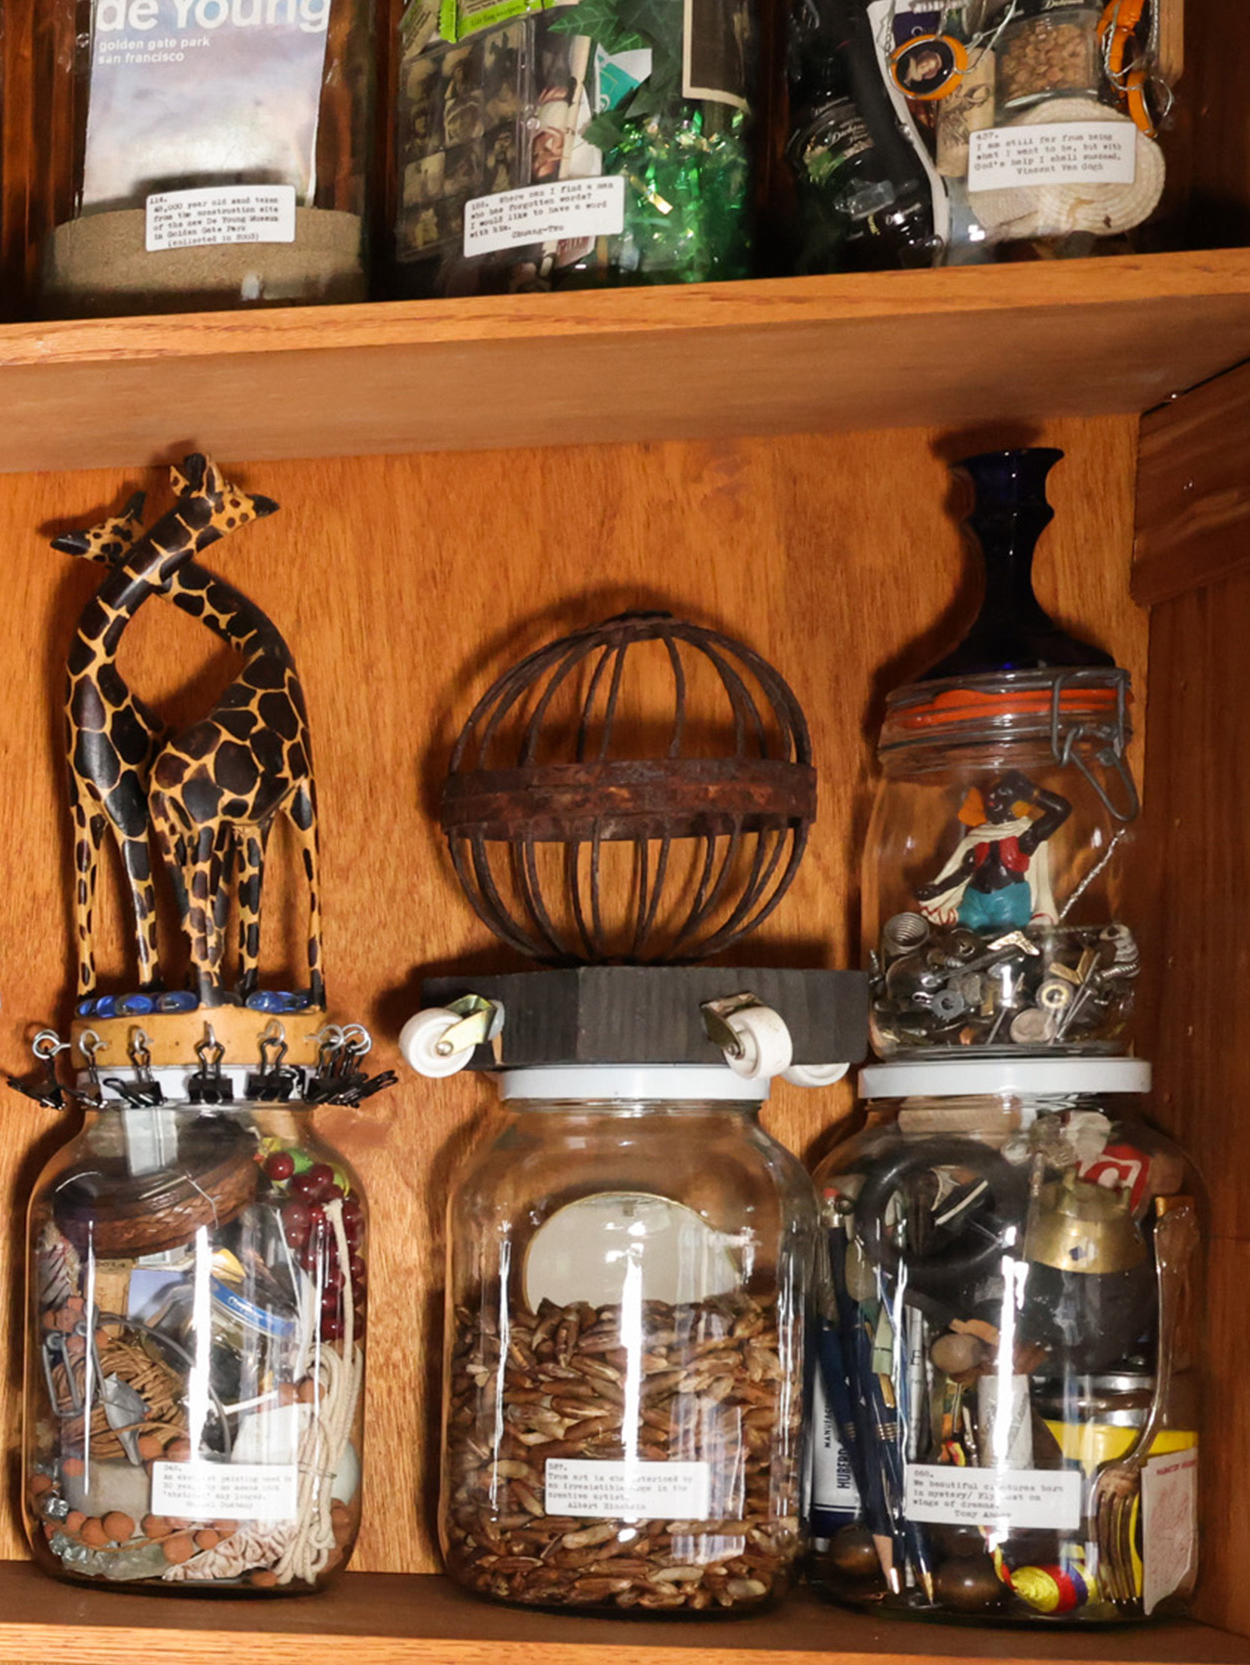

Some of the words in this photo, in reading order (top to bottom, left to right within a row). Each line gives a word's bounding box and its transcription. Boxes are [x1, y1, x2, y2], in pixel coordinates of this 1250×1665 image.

[100, 39, 143, 52] golden
[149, 40, 176, 50] gate
[181, 37, 210, 48] park
[99, 54, 121, 64] san
[126, 51, 184, 63] francisco
[1006, 139, 1033, 147] still
[1040, 136, 1056, 144] far
[1089, 134, 1112, 142] being
[1017, 148, 1038, 156] want
[1011, 159, 1034, 167] help
[1051, 154, 1077, 162] shall
[1017, 166, 1056, 175] Vincent
[500, 194, 524, 203] Where
[188, 201, 207, 210] year
[471, 211, 484, 219] who
[489, 207, 503, 215] has
[509, 198, 555, 211] forgotten
[154, 214, 172, 222] from
[198, 206, 255, 216] construction
[480, 216, 503, 226] would
[508, 212, 527, 221] like
[549, 206, 570, 214] have
[586, 201, 607, 209] word
[168, 228, 197, 238] Golden
[202, 226, 222, 234] Gate
[470, 228, 489, 238] with
[823, 1404, 832, 1448] MANUFAC
[563, 1483, 624, 1491] irresistible
[930, 1482, 978, 1490] beautiful
[548, 1492, 587, 1500] creative
[955, 1511, 977, 1519] Tony
